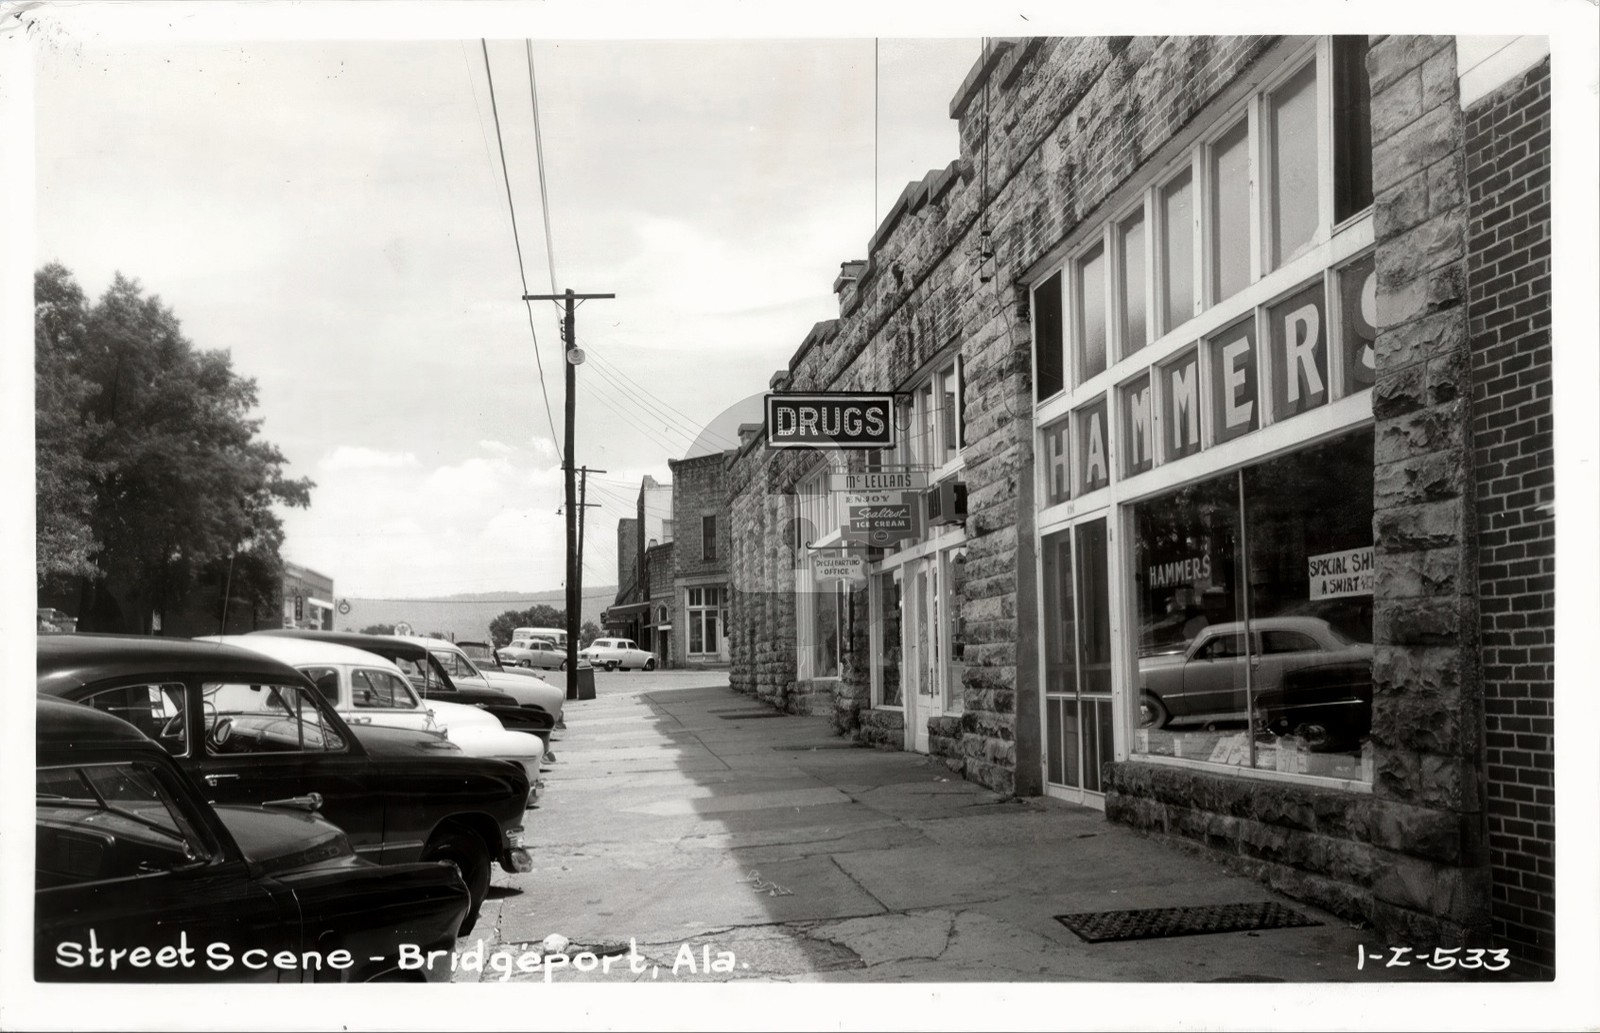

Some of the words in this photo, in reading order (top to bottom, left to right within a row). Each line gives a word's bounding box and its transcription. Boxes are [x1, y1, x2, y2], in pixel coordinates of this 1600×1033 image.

[777, 407, 884, 436] DRUGS
[845, 495, 889, 503] ENJOY
[858, 507, 907, 519] Sealtest
[1149, 554, 1211, 587] HAMMERS
[1310, 556, 1347, 577] SPECIAL
[1322, 580, 1327, 595] A
[1329, 575, 1360, 594] SHIRT
